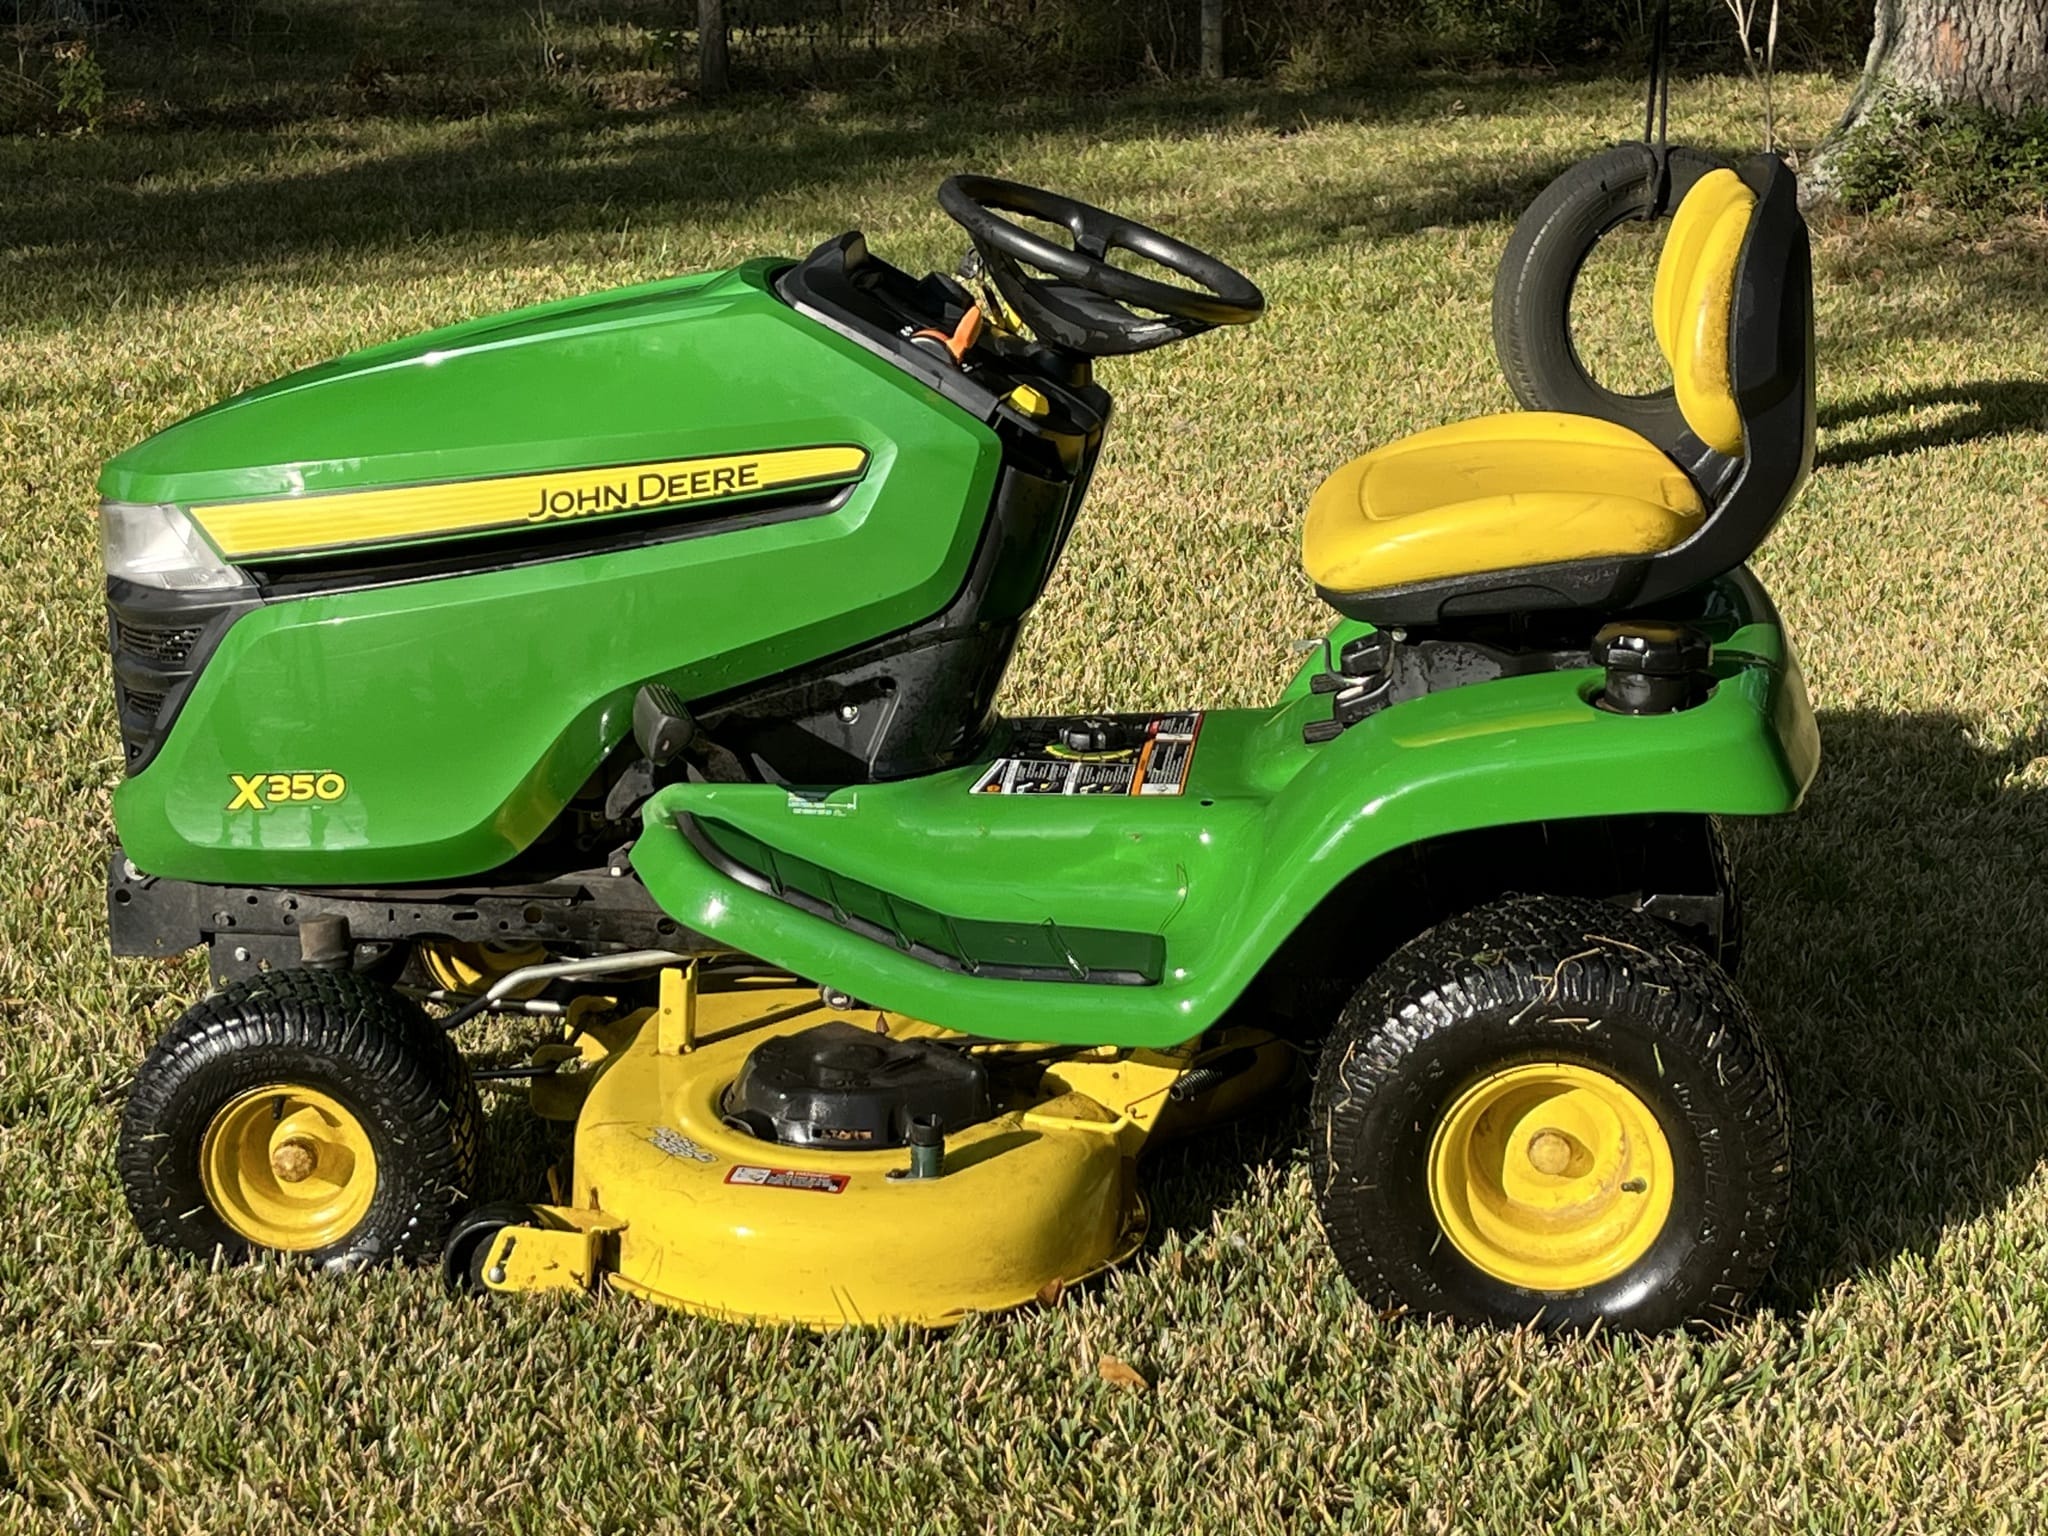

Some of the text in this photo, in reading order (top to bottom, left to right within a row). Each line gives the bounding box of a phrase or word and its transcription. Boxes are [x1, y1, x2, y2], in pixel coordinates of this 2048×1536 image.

[528, 463, 759, 518] JOHN DEERE
[224, 771, 347, 811] X350
